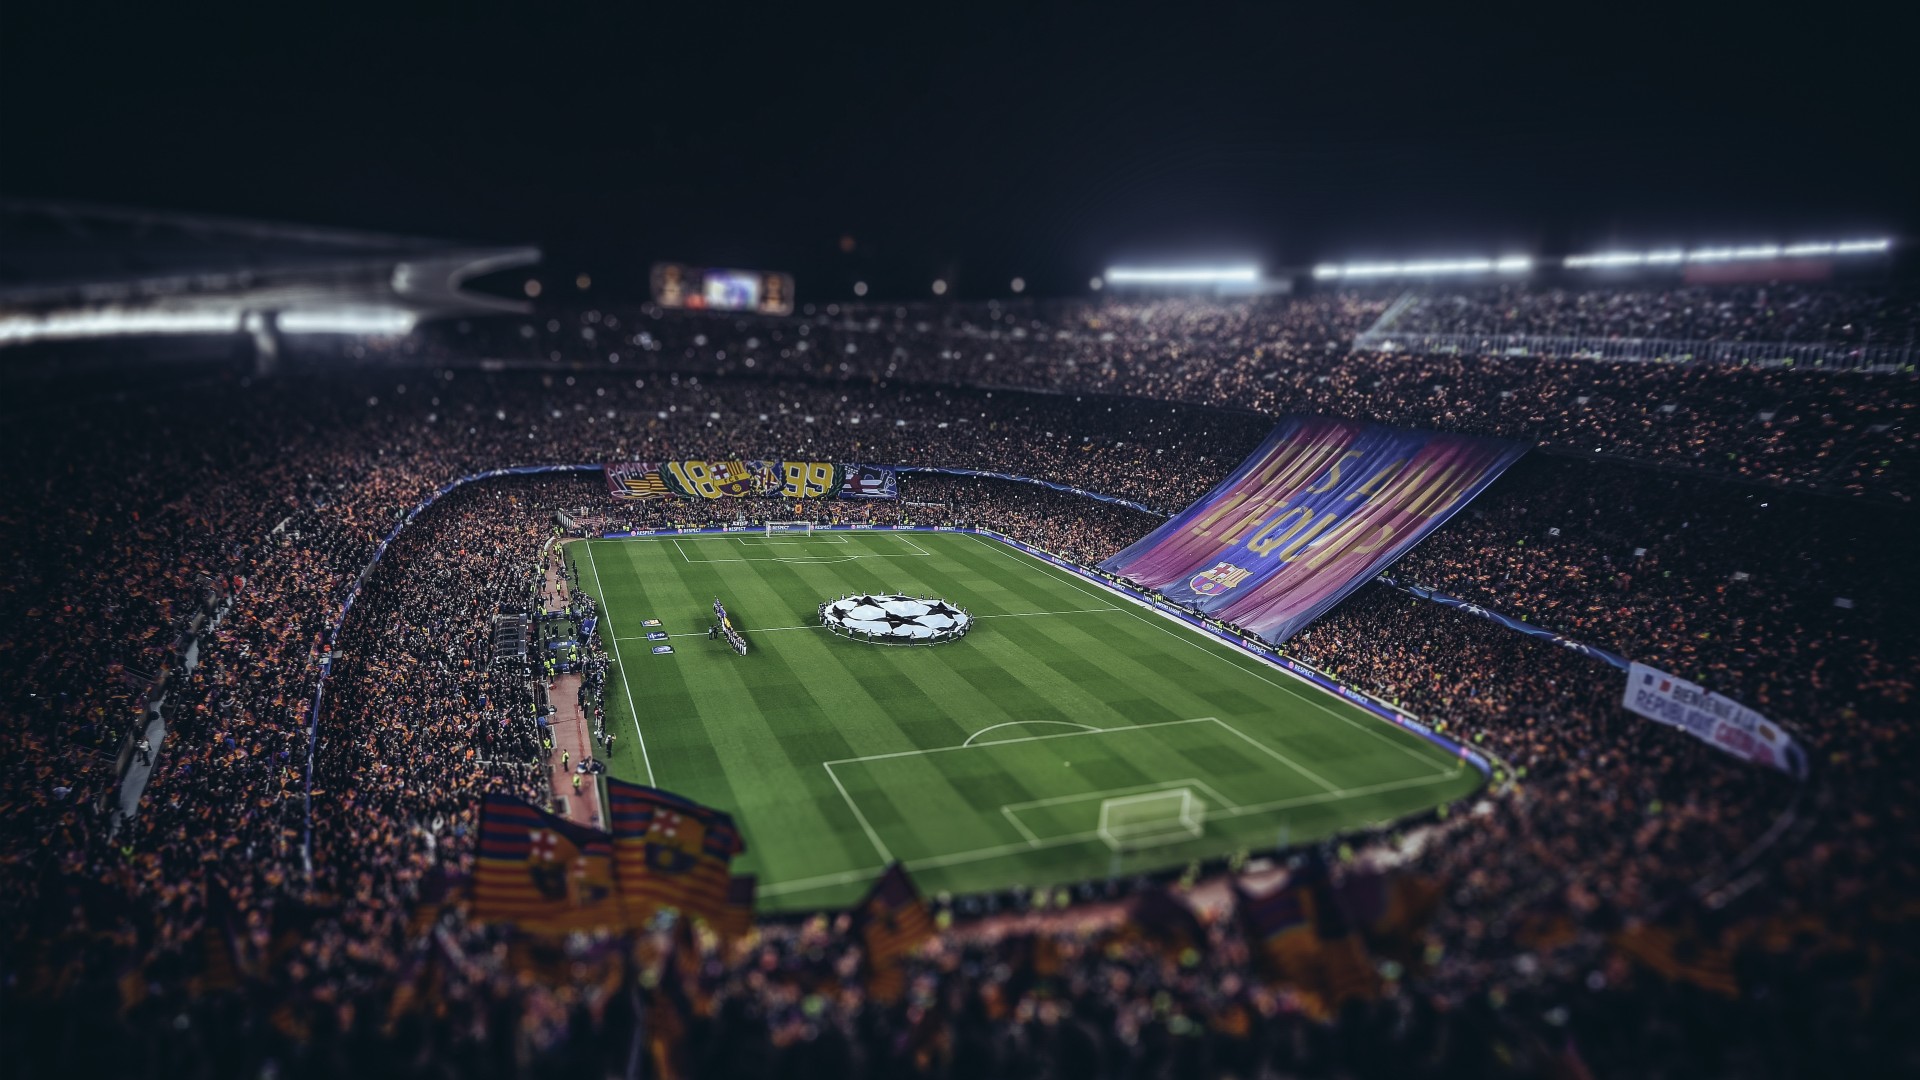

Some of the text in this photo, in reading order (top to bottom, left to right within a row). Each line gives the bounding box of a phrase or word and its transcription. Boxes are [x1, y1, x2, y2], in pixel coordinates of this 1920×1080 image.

[668, 461, 835, 498] 18 99
[1247, 643, 1267, 655] RESPECT
[1294, 664, 1315, 678] RESPECT
